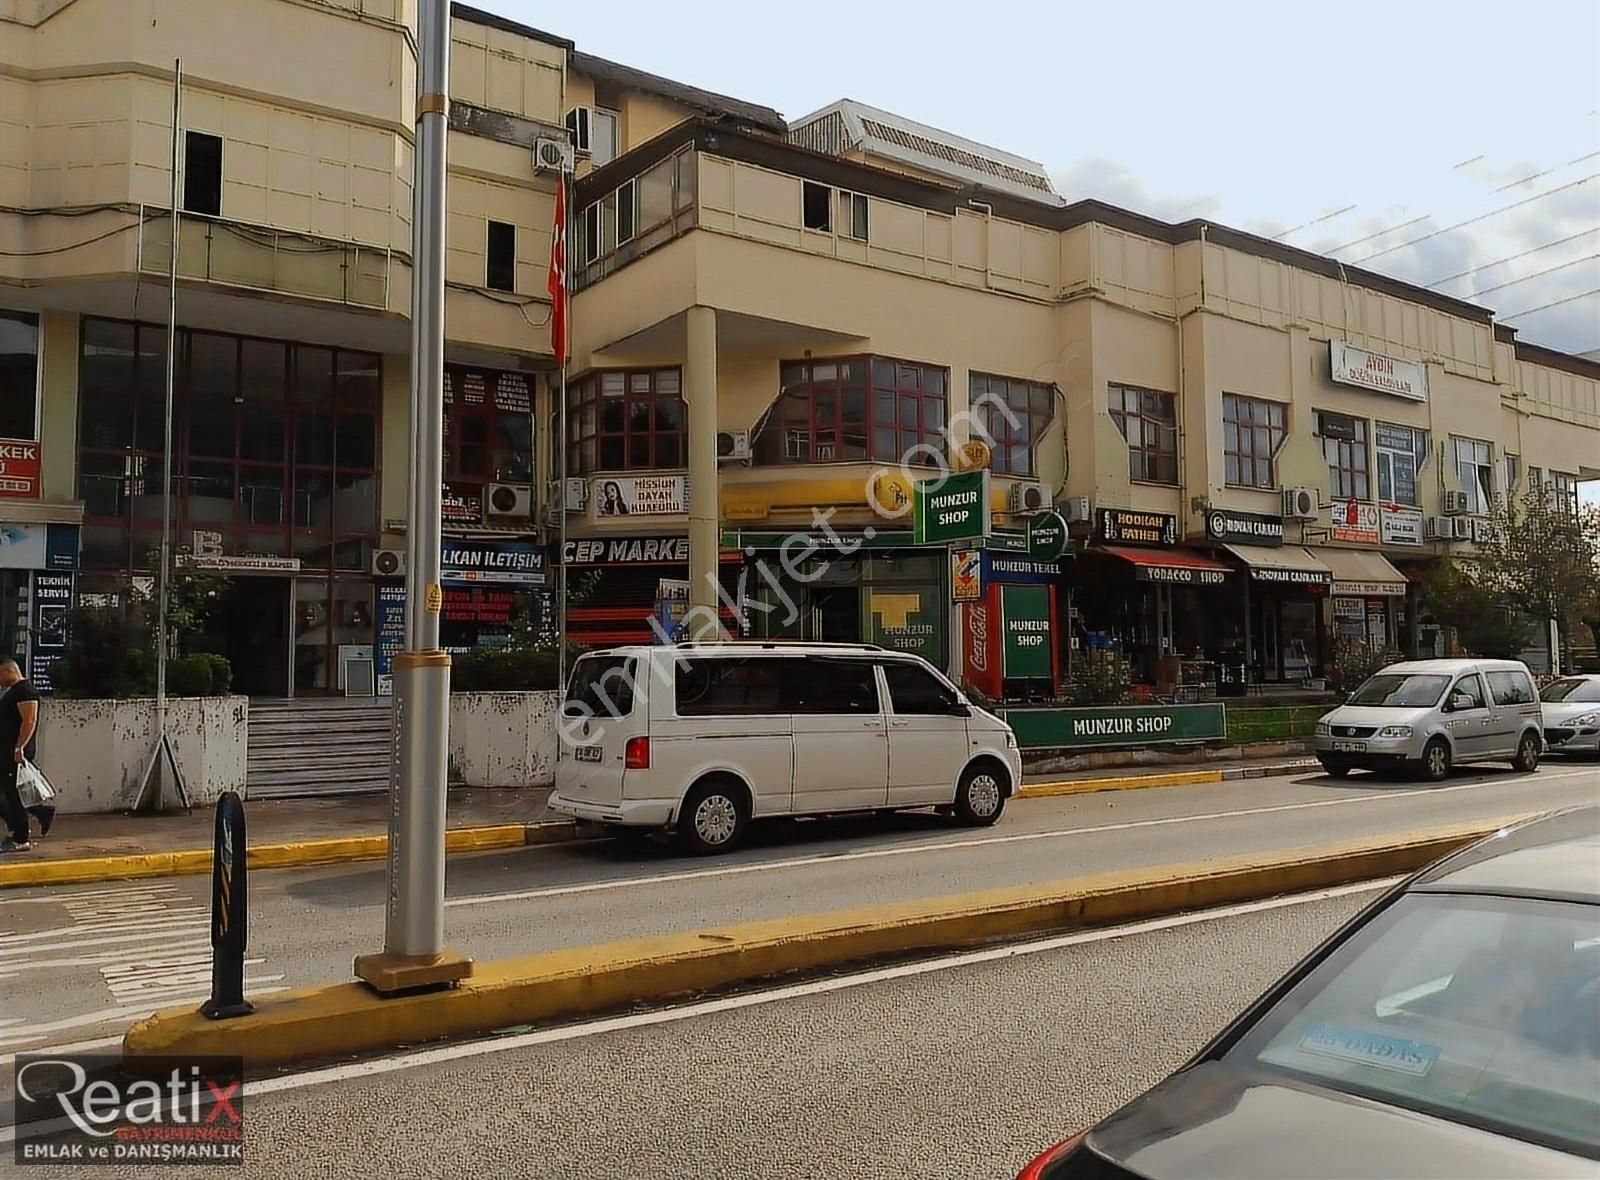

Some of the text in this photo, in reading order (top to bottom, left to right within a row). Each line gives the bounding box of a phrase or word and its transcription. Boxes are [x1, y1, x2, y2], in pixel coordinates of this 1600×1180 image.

[930, 491, 978, 509] MUNZUR
[938, 510, 969, 525] SHOP
[1117, 512, 1163, 528] HOOKAH
[1121, 528, 1159, 541] FATHER
[563, 539, 689, 563] CEP MARKE
[442, 549, 542, 570] LKAN İLETİŞİM
[992, 560, 1061, 574] MUNZUR TEKEL
[1147, 567, 1225, 584] TOBACCO SHOP
[37, 588, 70, 598] SERVİS
[1009, 620, 1050, 631] MUNZUR
[893, 637, 925, 648] SHOP
[1017, 635, 1043, 646] SHOP
[1073, 716, 1172, 736] MUNZUR SHOP
